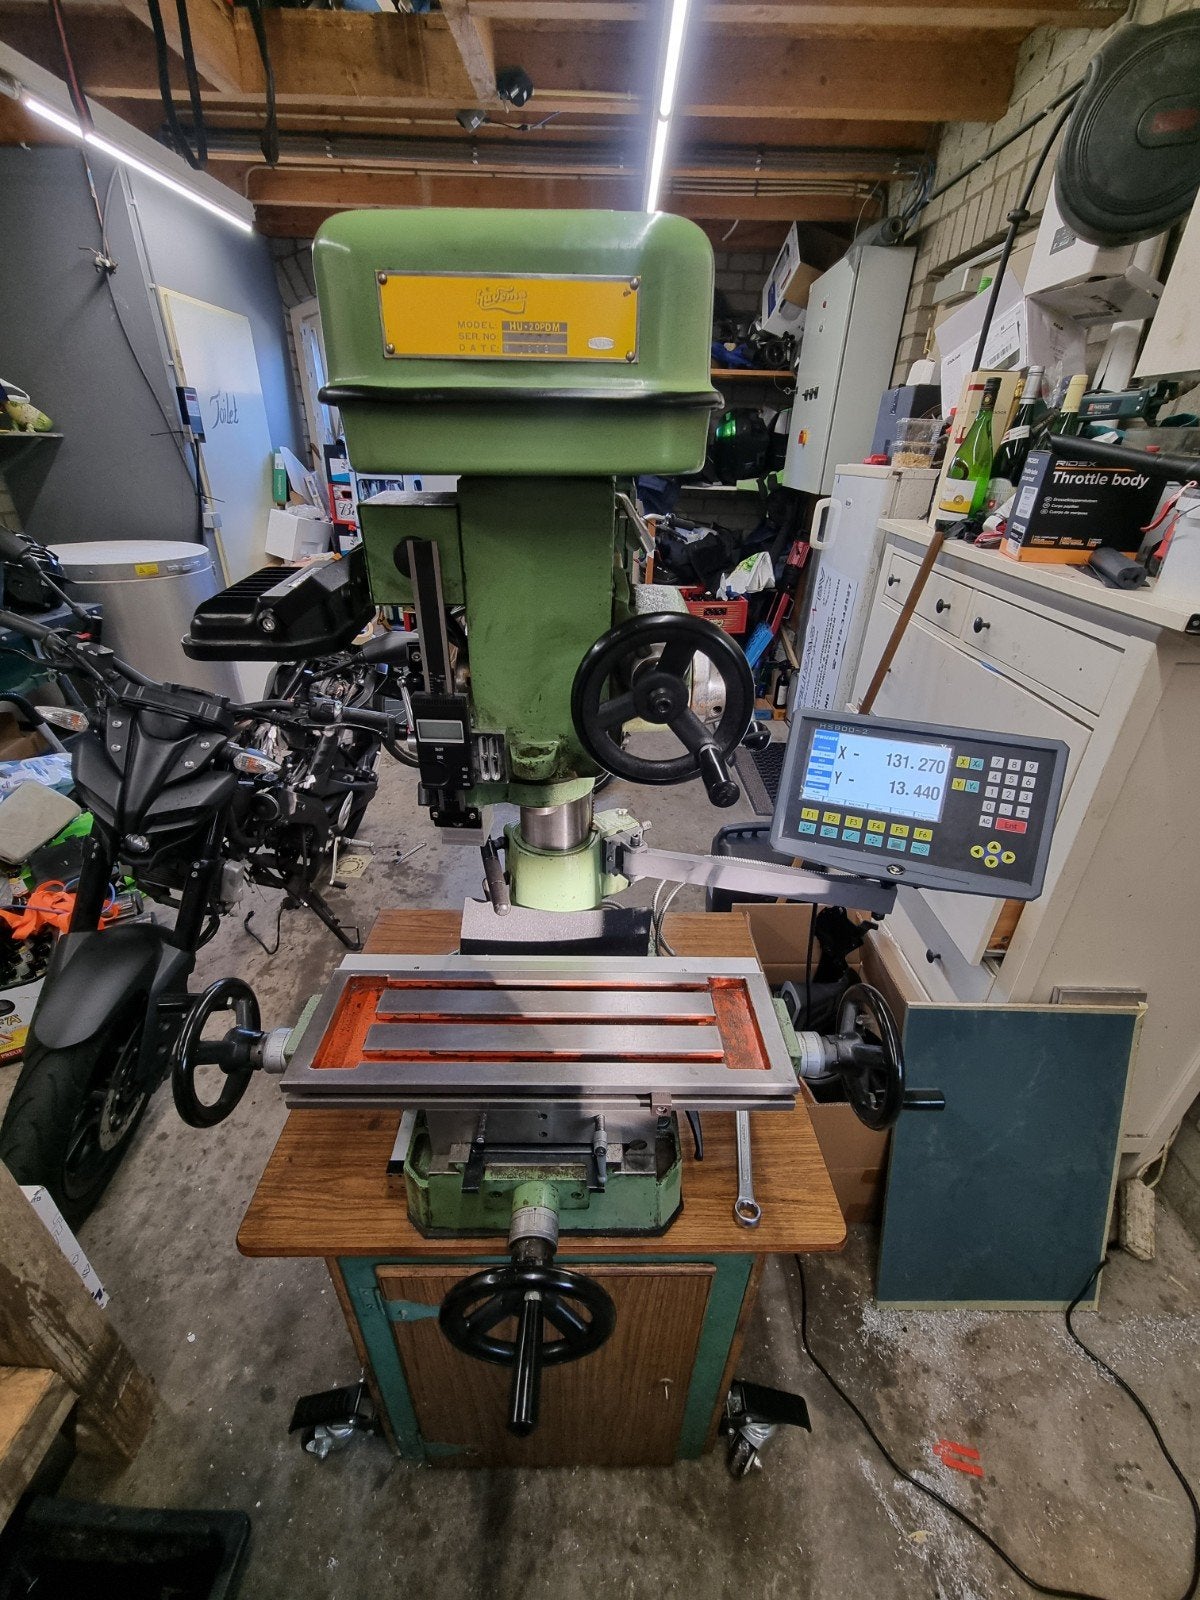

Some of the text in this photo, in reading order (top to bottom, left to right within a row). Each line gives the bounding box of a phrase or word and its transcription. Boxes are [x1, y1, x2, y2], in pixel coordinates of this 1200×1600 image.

[1053, 471, 1108, 485] Throttle
[1111, 473, 1150, 490] body
[837, 745, 848, 760] X
[885, 752, 946, 775] 131.270
[834, 770, 843, 785] Y
[889, 780, 941, 801] 13.440
